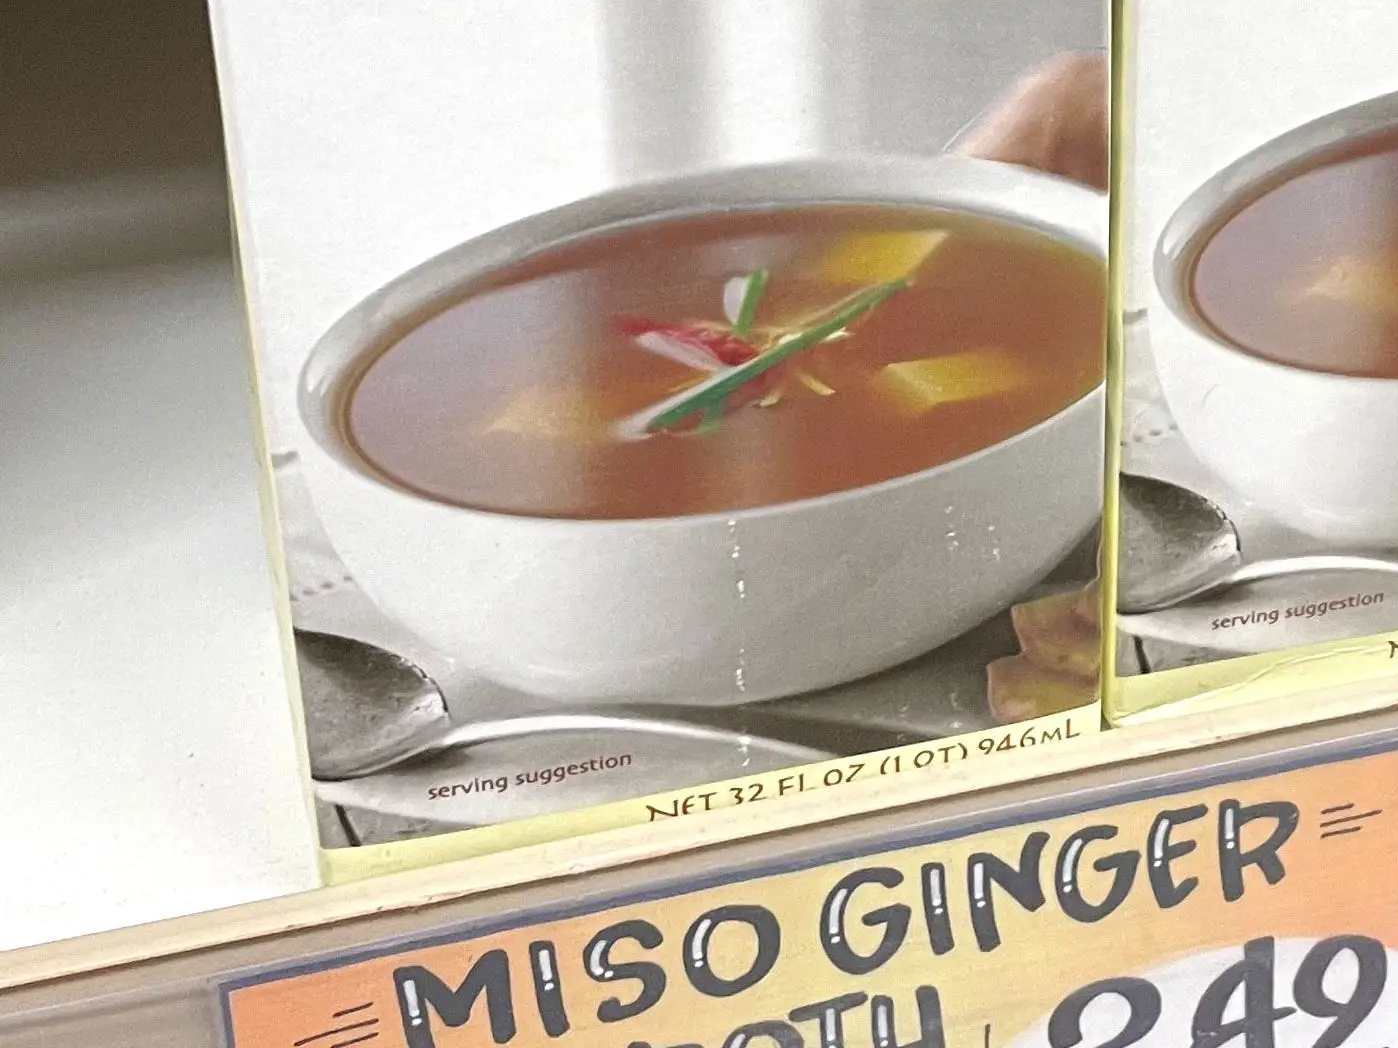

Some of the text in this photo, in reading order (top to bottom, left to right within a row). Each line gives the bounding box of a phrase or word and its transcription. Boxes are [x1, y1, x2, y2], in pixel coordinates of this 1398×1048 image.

[1212, 593, 1384, 630] serving suggestion
[428, 754, 631, 800] serving suggestion
[730, 783, 767, 804] 32
[778, 773, 815, 796] FL
[393, 799, 1299, 1048] MISO GINGER
